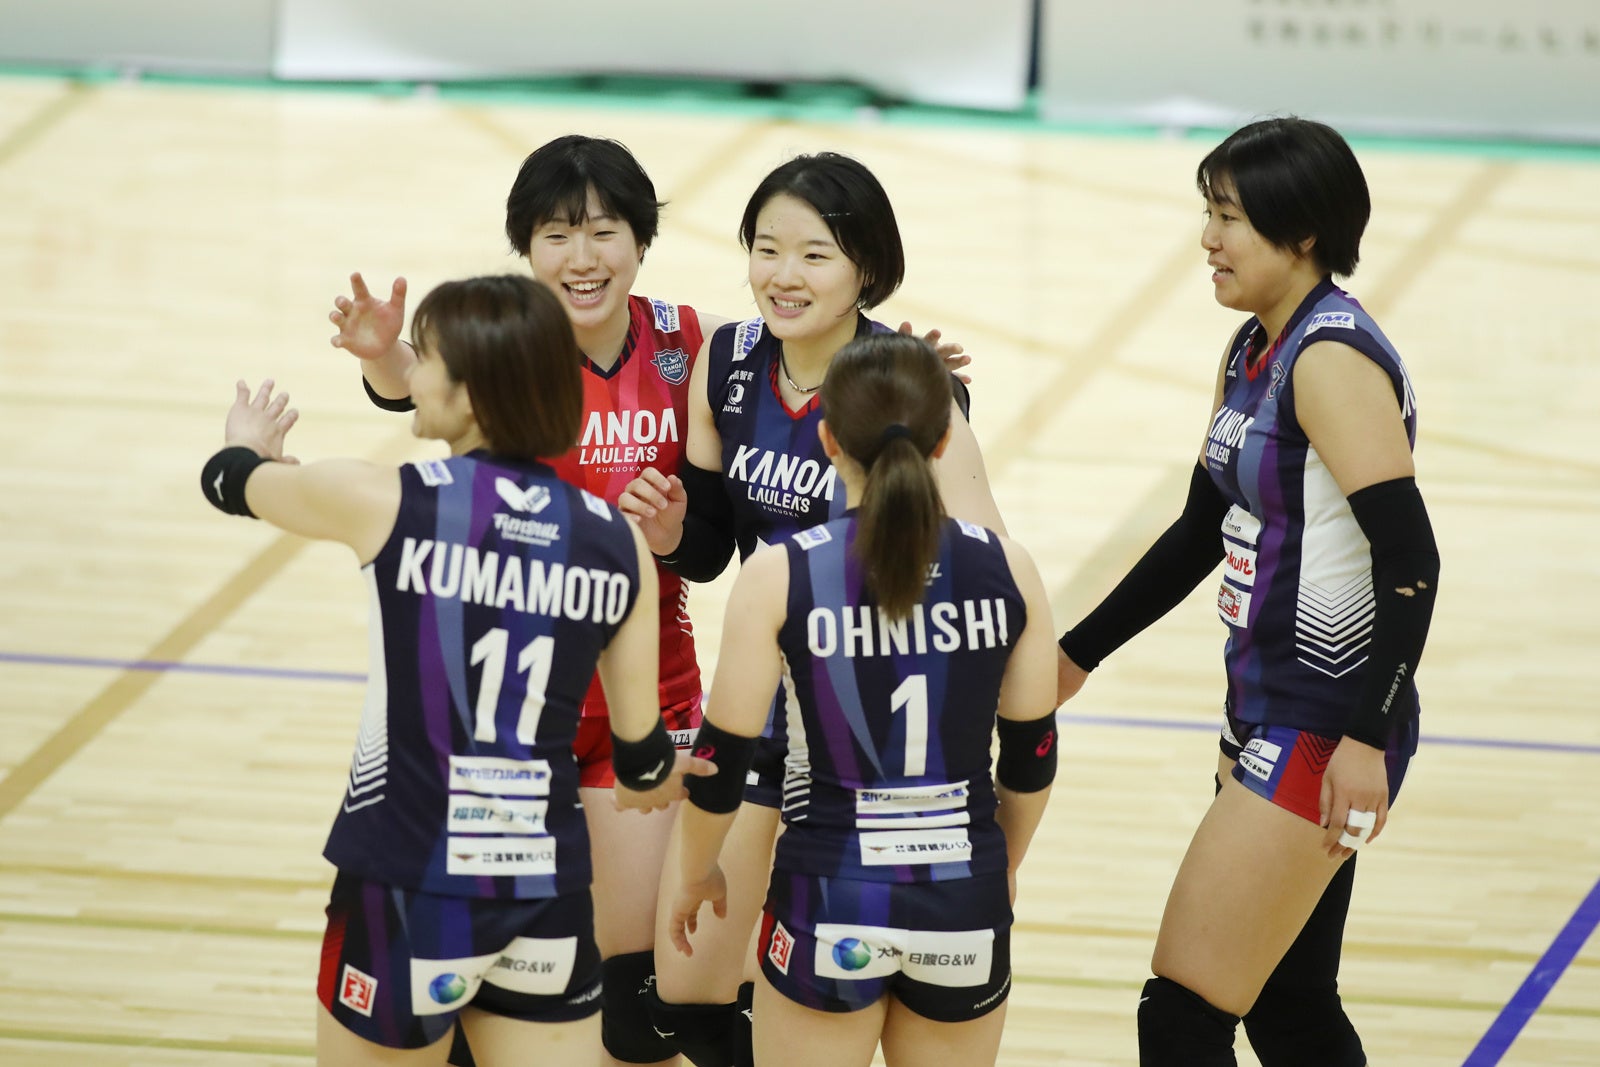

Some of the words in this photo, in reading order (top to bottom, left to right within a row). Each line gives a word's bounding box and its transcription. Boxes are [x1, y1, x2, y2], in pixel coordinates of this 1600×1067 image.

[576, 407, 679, 447] ANOA
[579, 446, 659, 465] LAULEA'S
[596, 465, 641, 474] FUKUOKA
[728, 444, 838, 501] KANOA
[747, 485, 811, 513] LAULEA'S
[762, 505, 800, 519] FUKUOKA
[396, 536, 631, 626] KUMAMOTO
[806, 597, 1009, 658] OHNISHI
[469, 627, 556, 746] 11
[890, 673, 929, 778] 1
